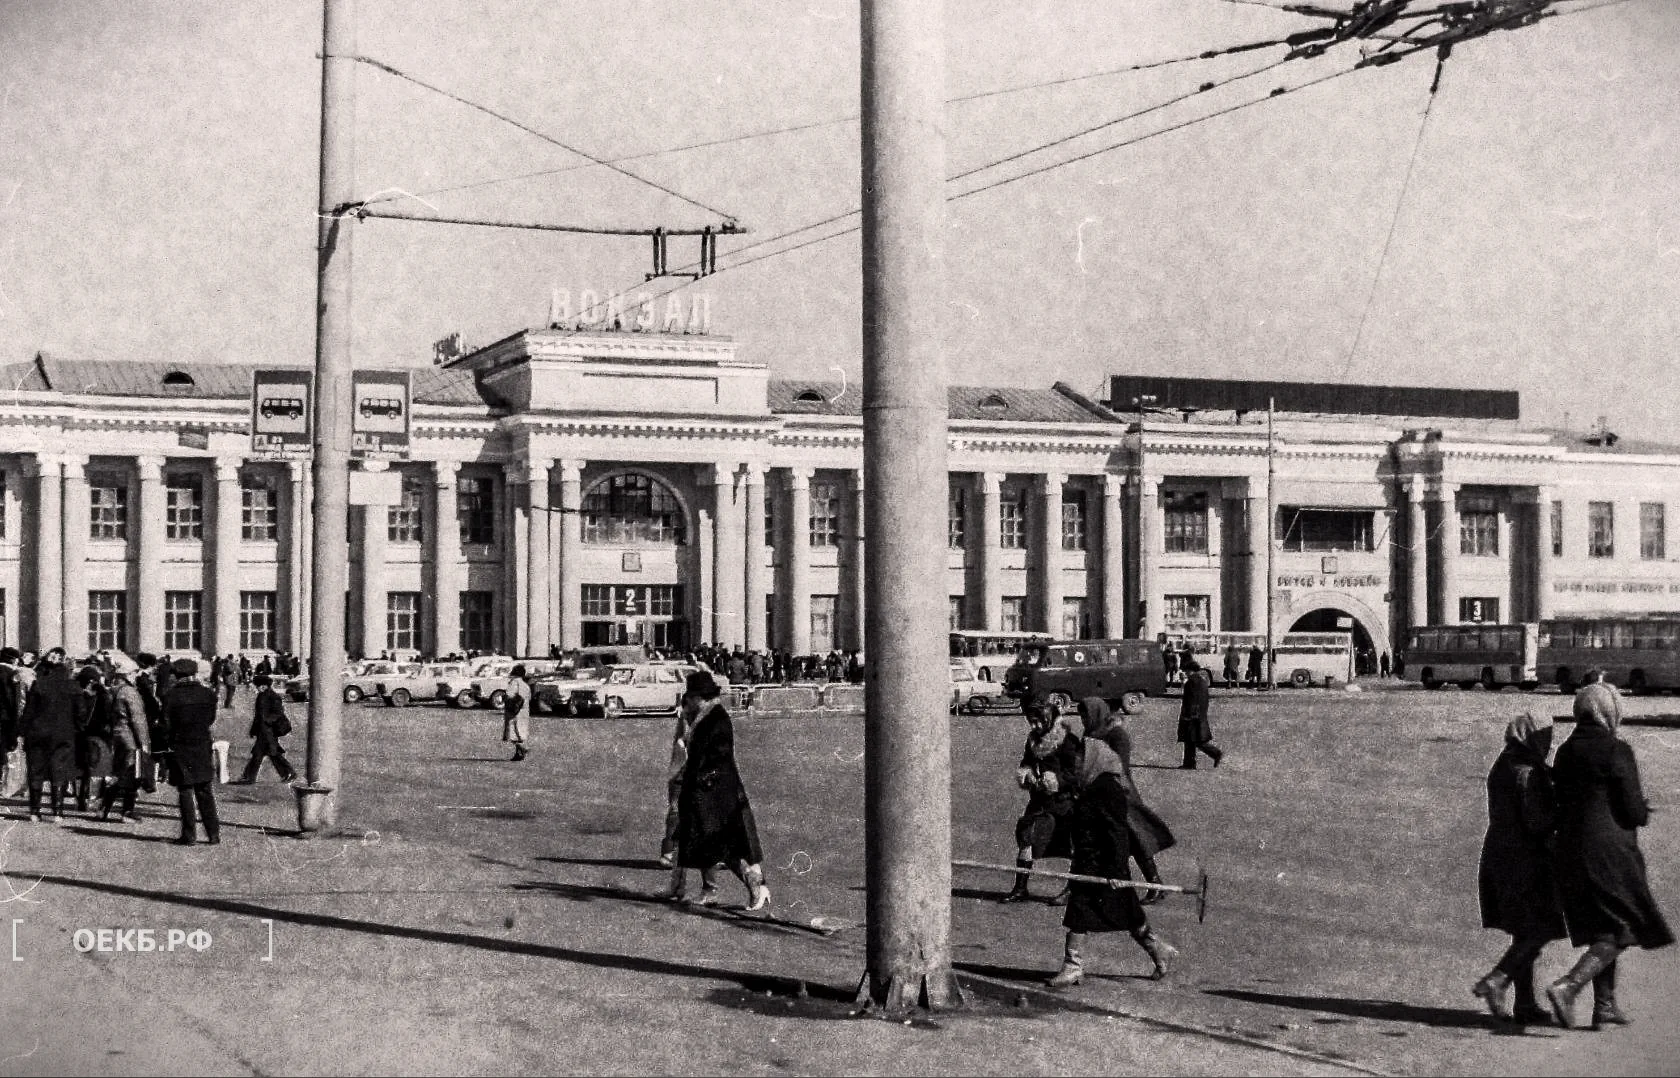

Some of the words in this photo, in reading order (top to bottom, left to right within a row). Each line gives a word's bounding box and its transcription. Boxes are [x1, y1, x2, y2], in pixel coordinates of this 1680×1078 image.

[551, 287, 711, 331] ВОКЗАЛ
[625, 588, 636, 607] 2
[1473, 600, 1481, 617] 3
